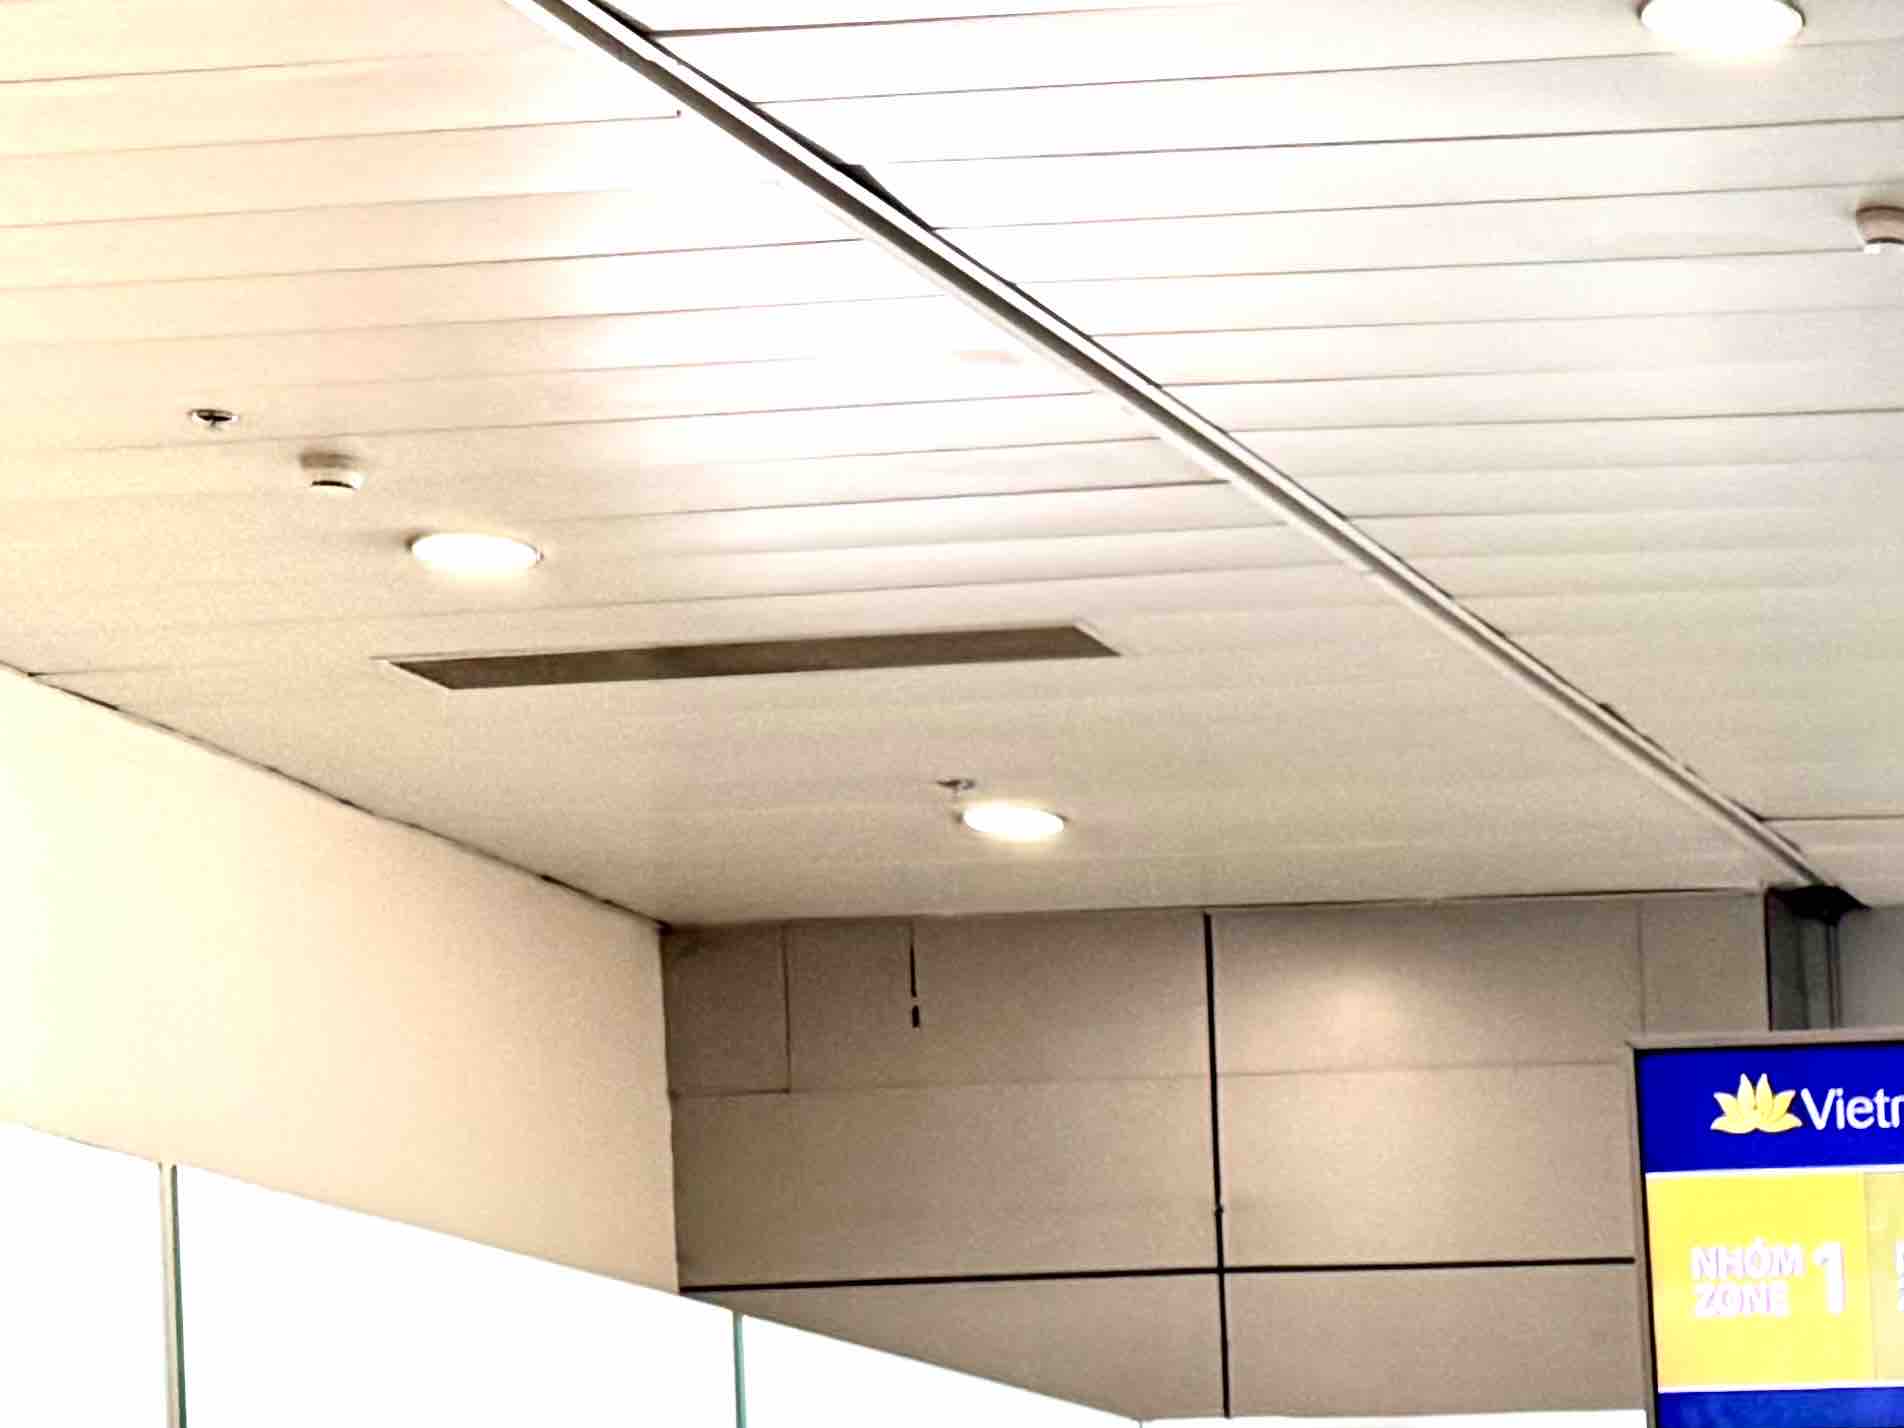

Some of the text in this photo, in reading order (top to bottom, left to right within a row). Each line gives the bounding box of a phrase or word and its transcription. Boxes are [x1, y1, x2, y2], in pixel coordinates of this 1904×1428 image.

[1690, 1235, 1804, 1280] NHÓM
[1811, 1241, 1845, 1316] 1
[1695, 1281, 1790, 1318] ZONE
